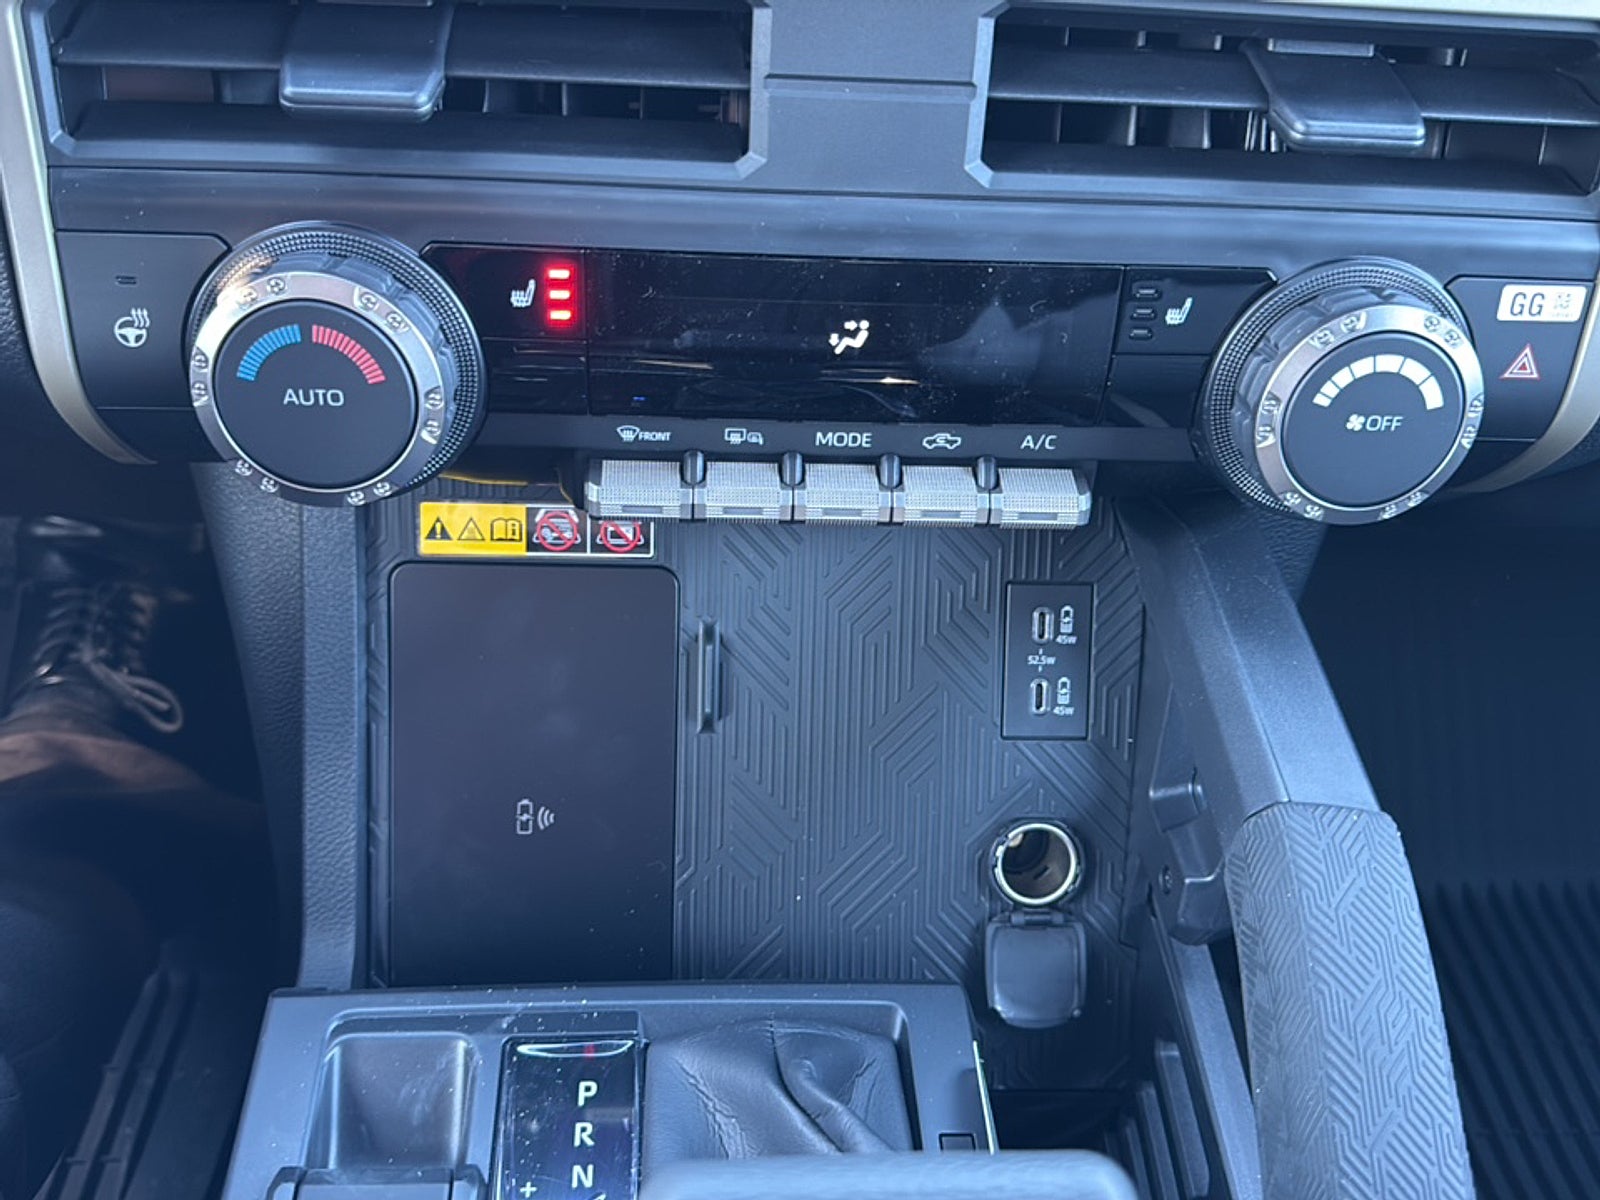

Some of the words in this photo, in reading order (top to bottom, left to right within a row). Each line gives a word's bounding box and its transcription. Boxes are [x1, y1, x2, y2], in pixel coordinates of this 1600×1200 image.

[283, 388, 345, 407] AUTO
[1366, 416, 1403, 432] OFF
[638, 431, 672, 442] FRONT
[815, 432, 872, 448] MODE
[1020, 435, 1057, 451] A/C
[1055, 635, 1077, 645] 45W
[1027, 654, 1056, 665] 52.5W
[1053, 706, 1075, 716] 45W
[577, 1080, 598, 1107] P
[573, 1122, 595, 1147] R
[571, 1164, 594, 1189] N
